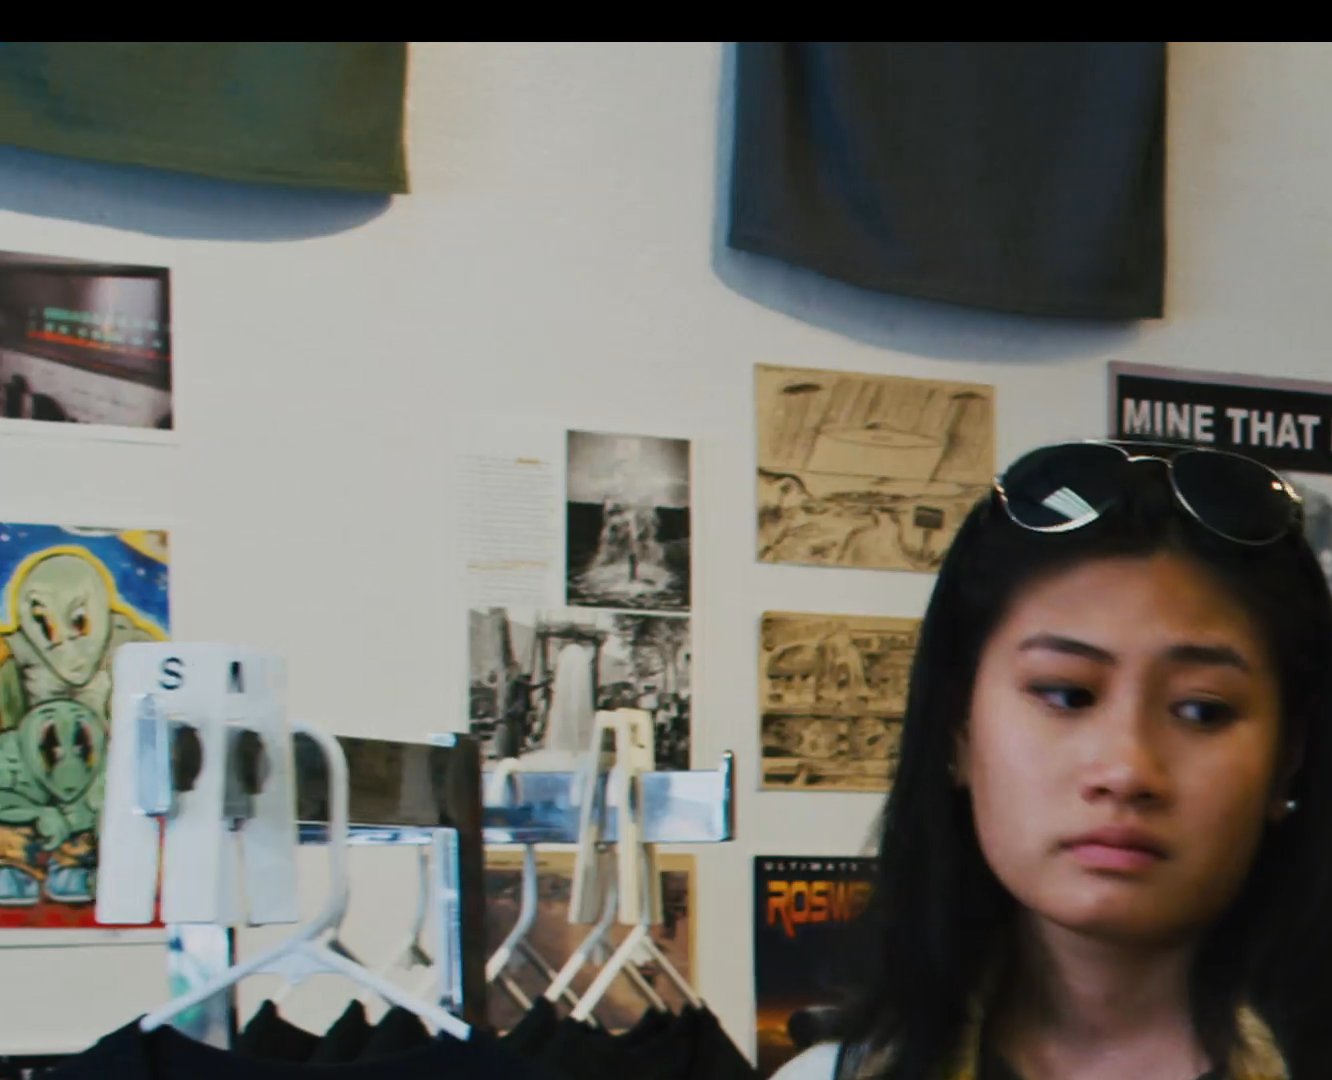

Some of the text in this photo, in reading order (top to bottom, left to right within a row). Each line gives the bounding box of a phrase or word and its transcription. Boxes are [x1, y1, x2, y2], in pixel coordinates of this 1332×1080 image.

[1122, 397, 1215, 442] MINE
[1226, 407, 1321, 451] THAT
[160, 657, 184, 690] S
[764, 861, 859, 872] ULTIMATE
